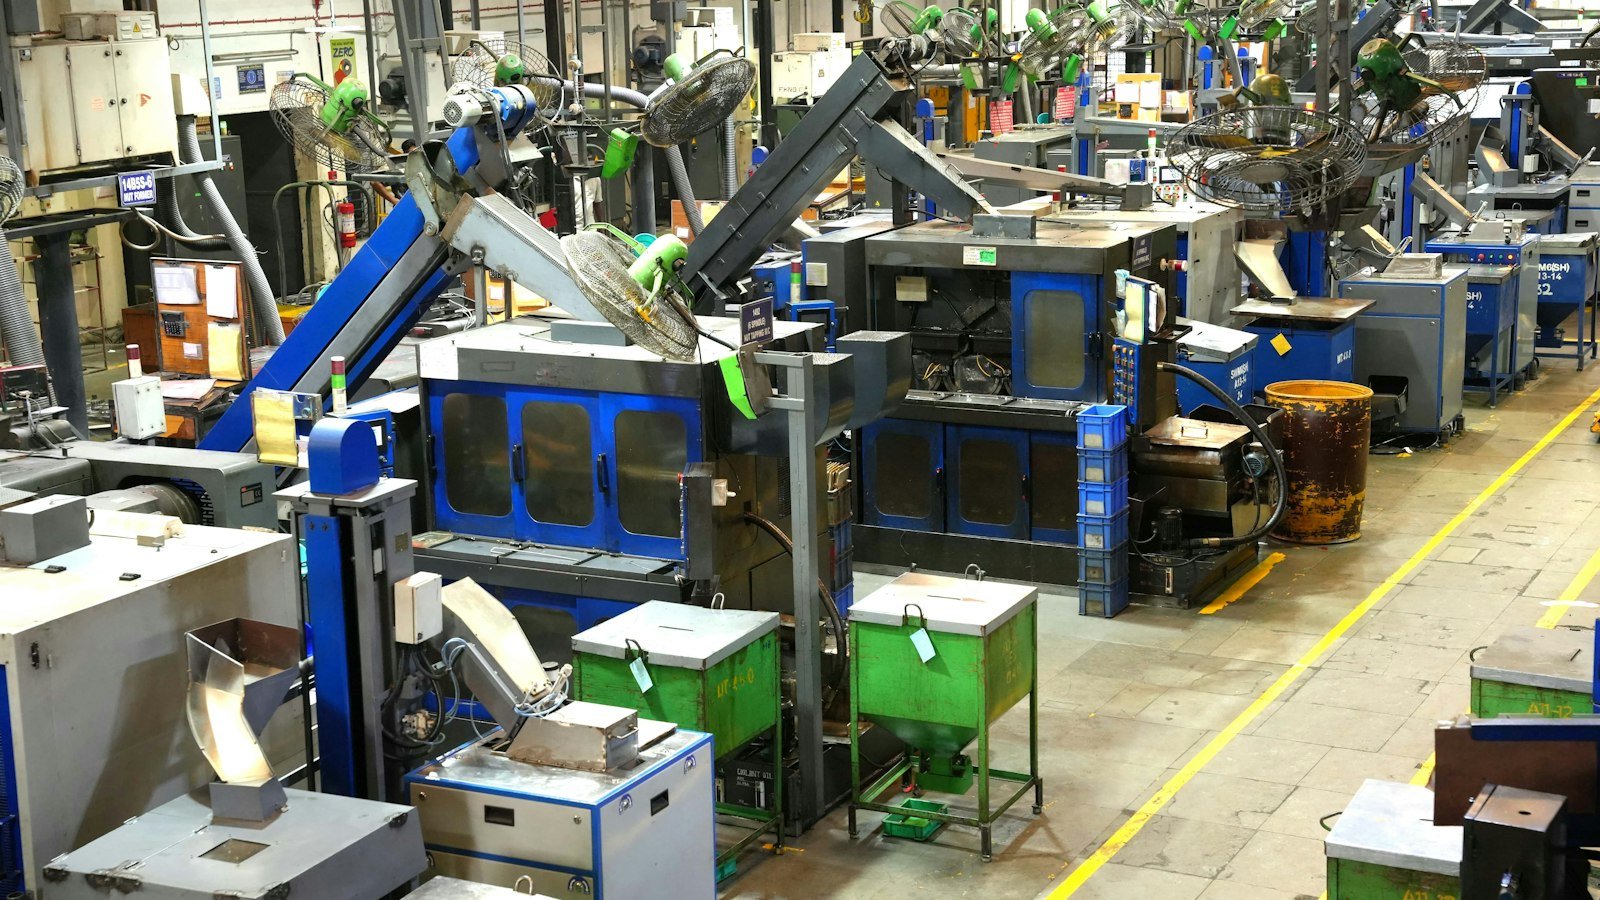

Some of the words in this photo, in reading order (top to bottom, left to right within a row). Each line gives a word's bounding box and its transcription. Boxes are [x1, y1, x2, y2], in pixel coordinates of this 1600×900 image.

[332, 46, 354, 58] ZERO
[122, 175, 152, 191] 14B5S-6
[123, 192, 134, 202] NUT
[134, 189, 153, 201] FORMER
[736, 768, 761, 778] COOLANT
[762, 771, 774, 780] OIL
